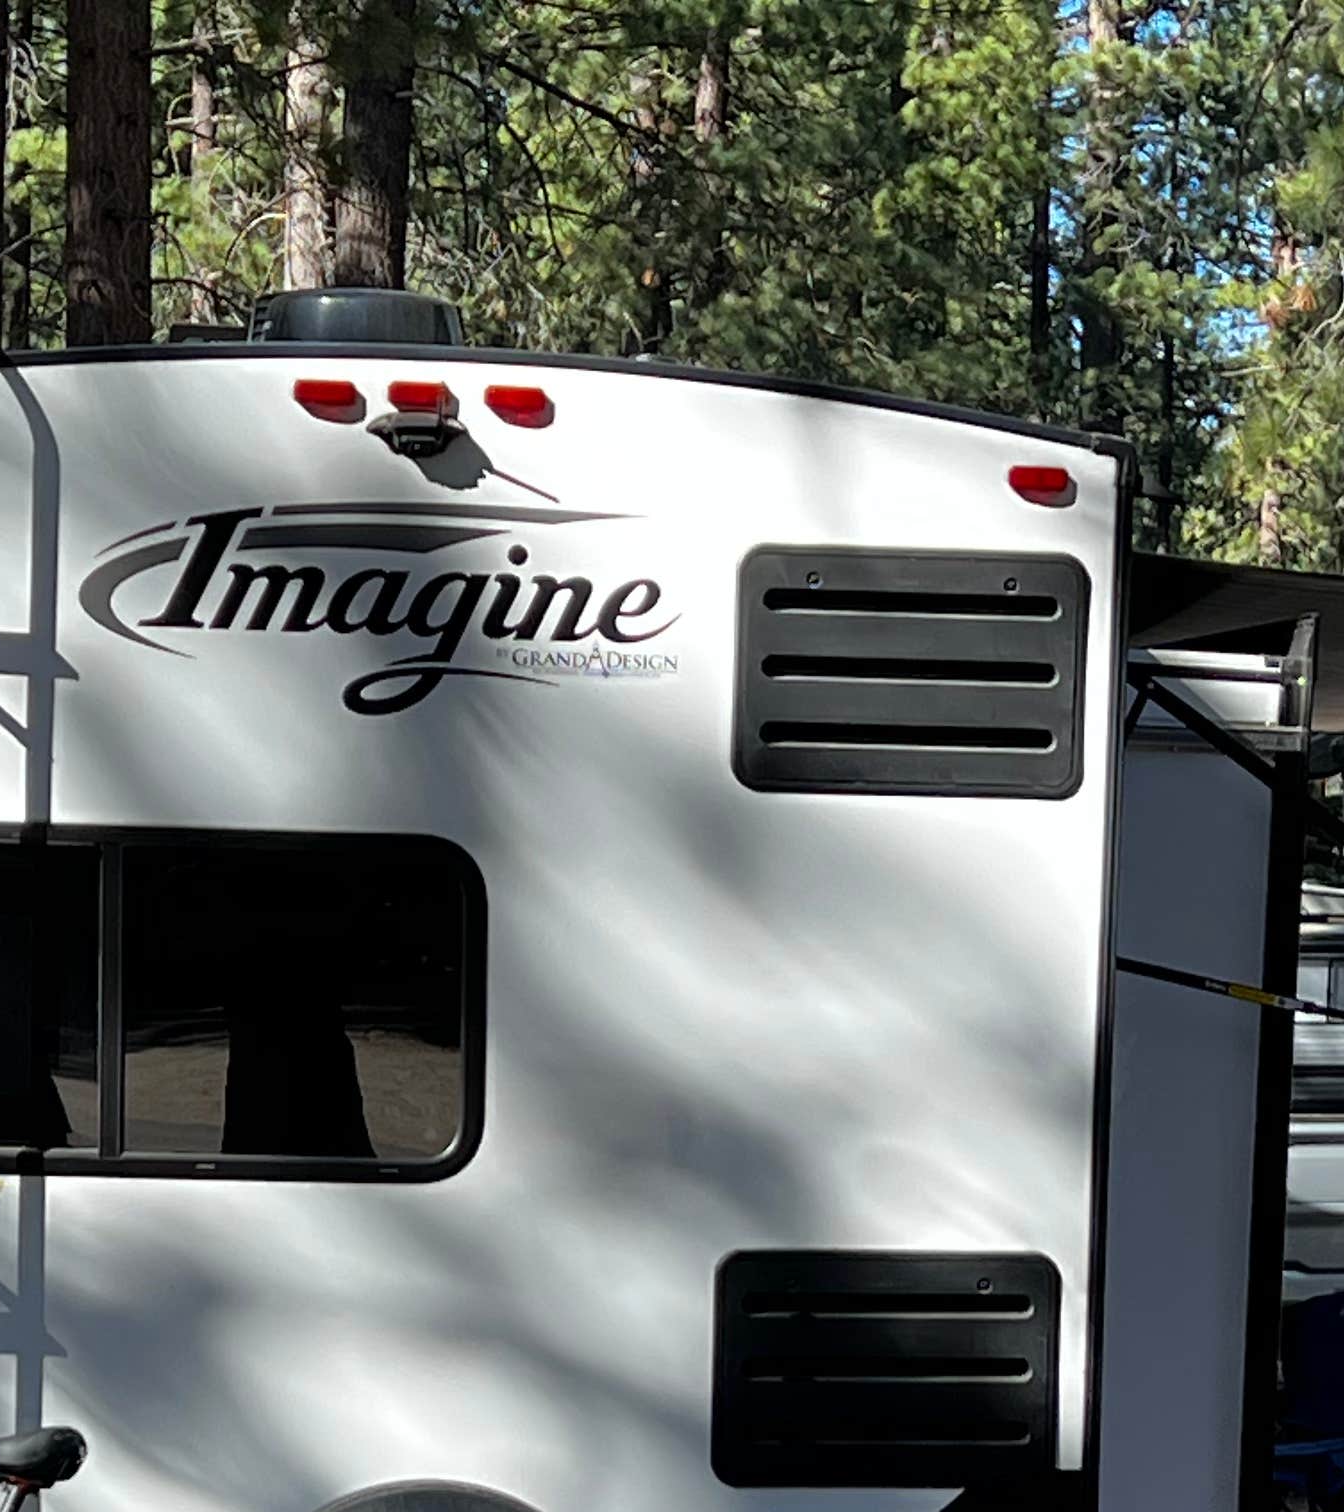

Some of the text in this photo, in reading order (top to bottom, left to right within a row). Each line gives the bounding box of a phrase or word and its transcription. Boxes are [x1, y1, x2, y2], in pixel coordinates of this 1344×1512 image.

[138, 506, 683, 716] Imagine
[513, 647, 586, 668] GRAND
[606, 650, 679, 671] DESIGN
